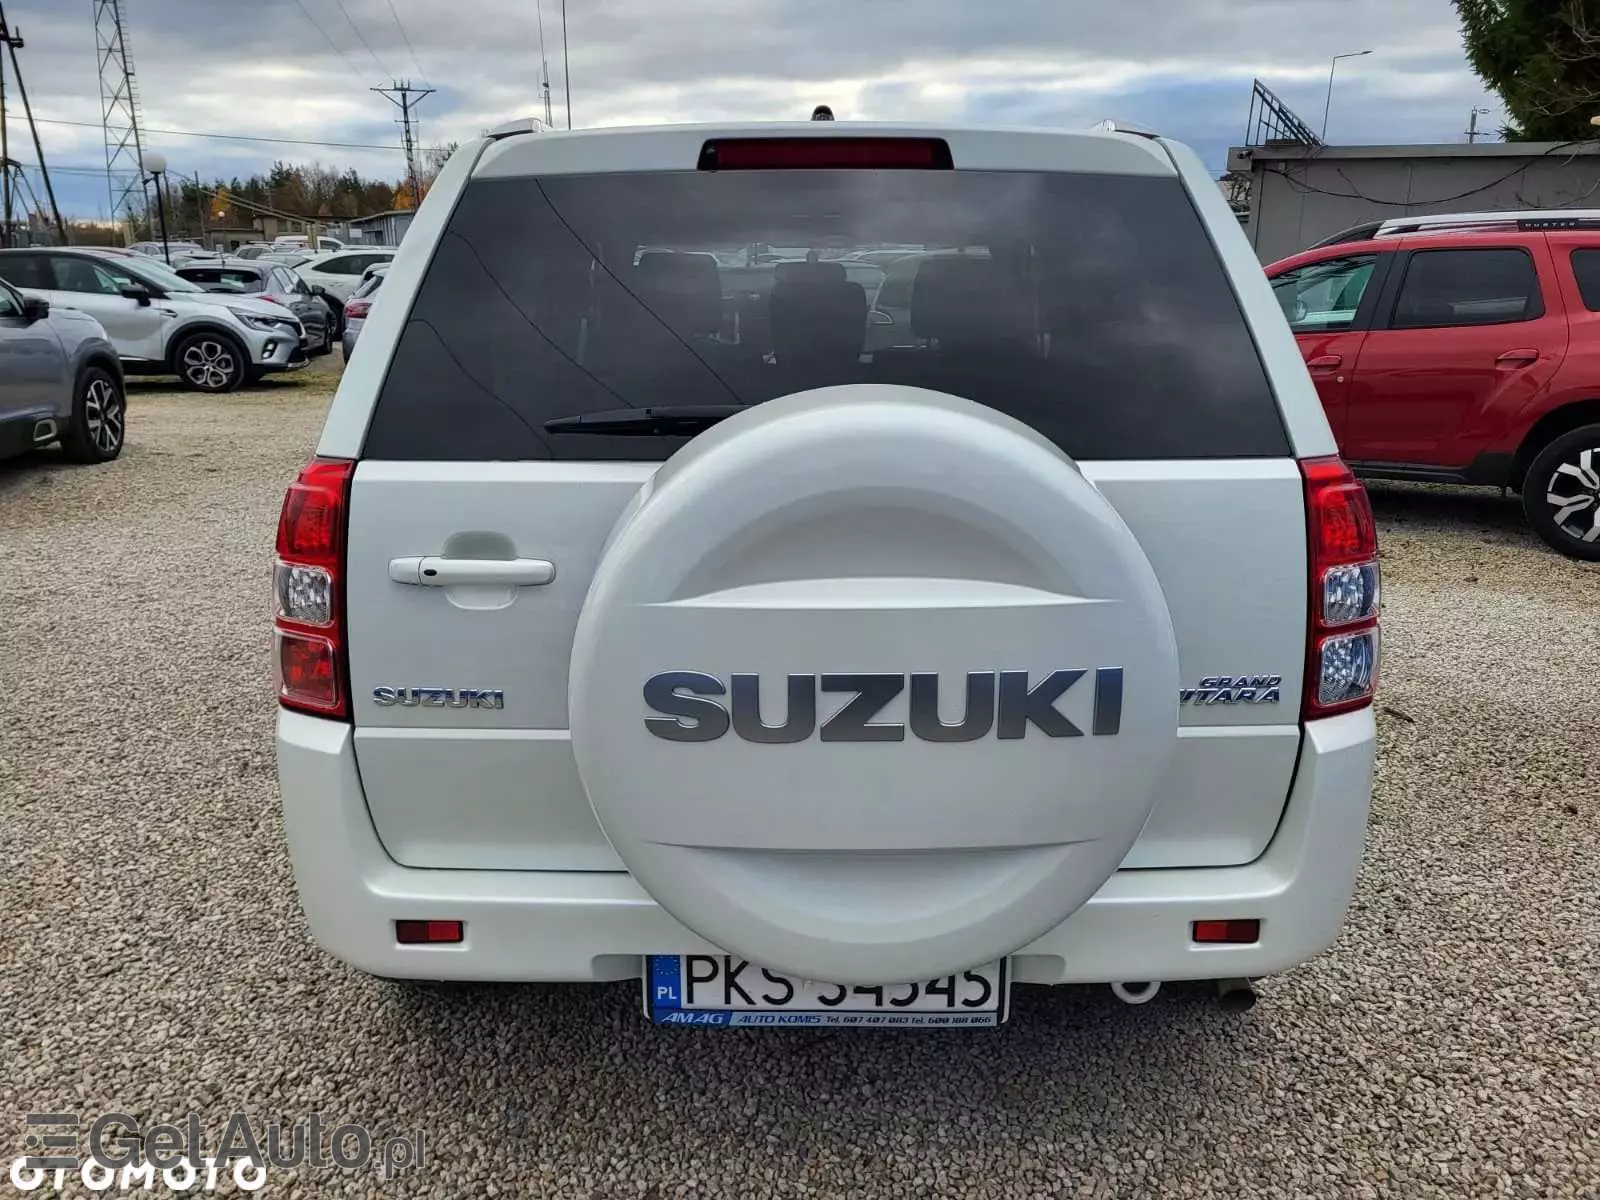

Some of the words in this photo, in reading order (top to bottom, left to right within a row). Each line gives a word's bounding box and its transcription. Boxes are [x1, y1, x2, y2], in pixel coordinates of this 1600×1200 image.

[1200, 674, 1281, 688] GRAND
[373, 686, 504, 709] SUZUKI
[643, 666, 1123, 744] SUZUKI
[686, 955, 794, 1005] PKS
[657, 986, 678, 1000] PL
[661, 1012, 725, 1024] AMAG
[738, 1015, 775, 1024] AUTO
[777, 1015, 821, 1025] KOMIS
